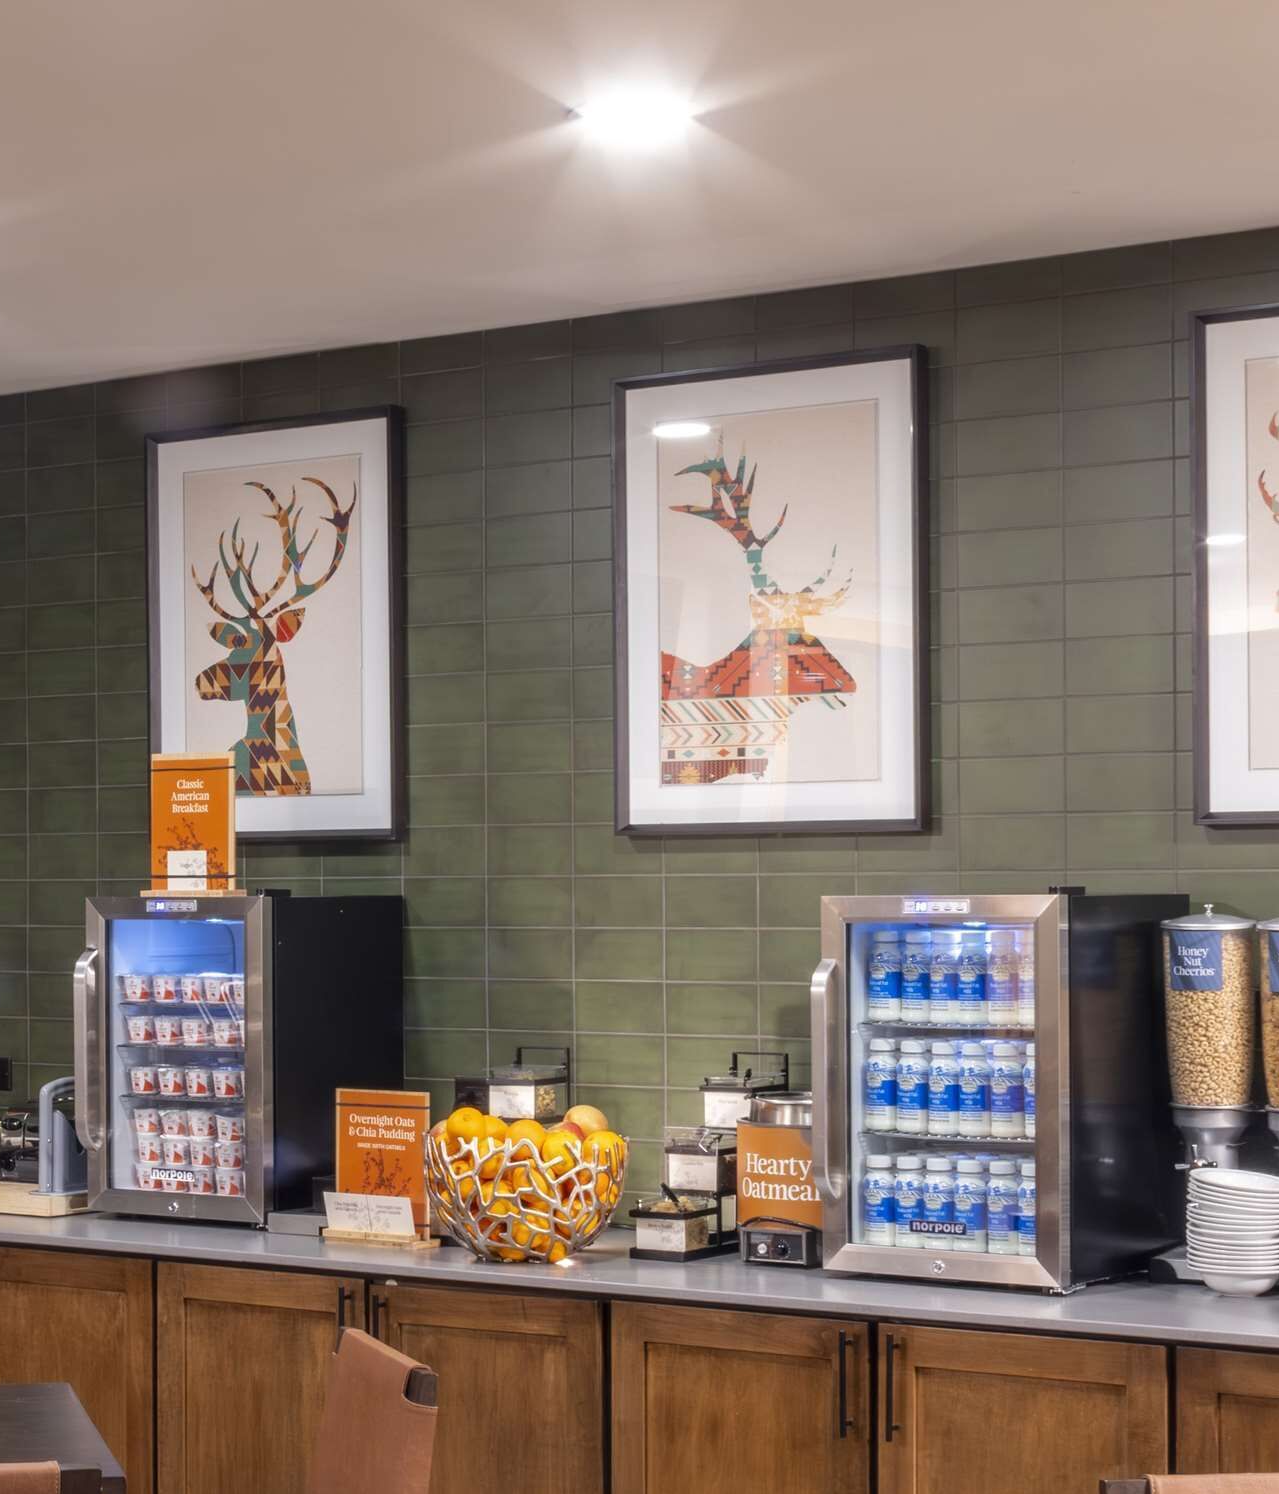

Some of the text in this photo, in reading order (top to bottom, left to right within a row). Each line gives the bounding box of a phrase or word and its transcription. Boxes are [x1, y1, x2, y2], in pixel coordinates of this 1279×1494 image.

[176, 779, 204, 789] Classic
[171, 791, 210, 801] American
[172, 803, 209, 814] Breakfast
[1177, 945, 1209, 957] Honey
[1183, 957, 1202, 966] Nut
[1173, 966, 1216, 977] Cheerios
[349, 1113, 415, 1128] Overnight Oats
[348, 1126, 416, 1143] & Chia Pudding
[746, 1152, 813, 1181] Hearty
[912, 1221, 964, 1233] norpole
